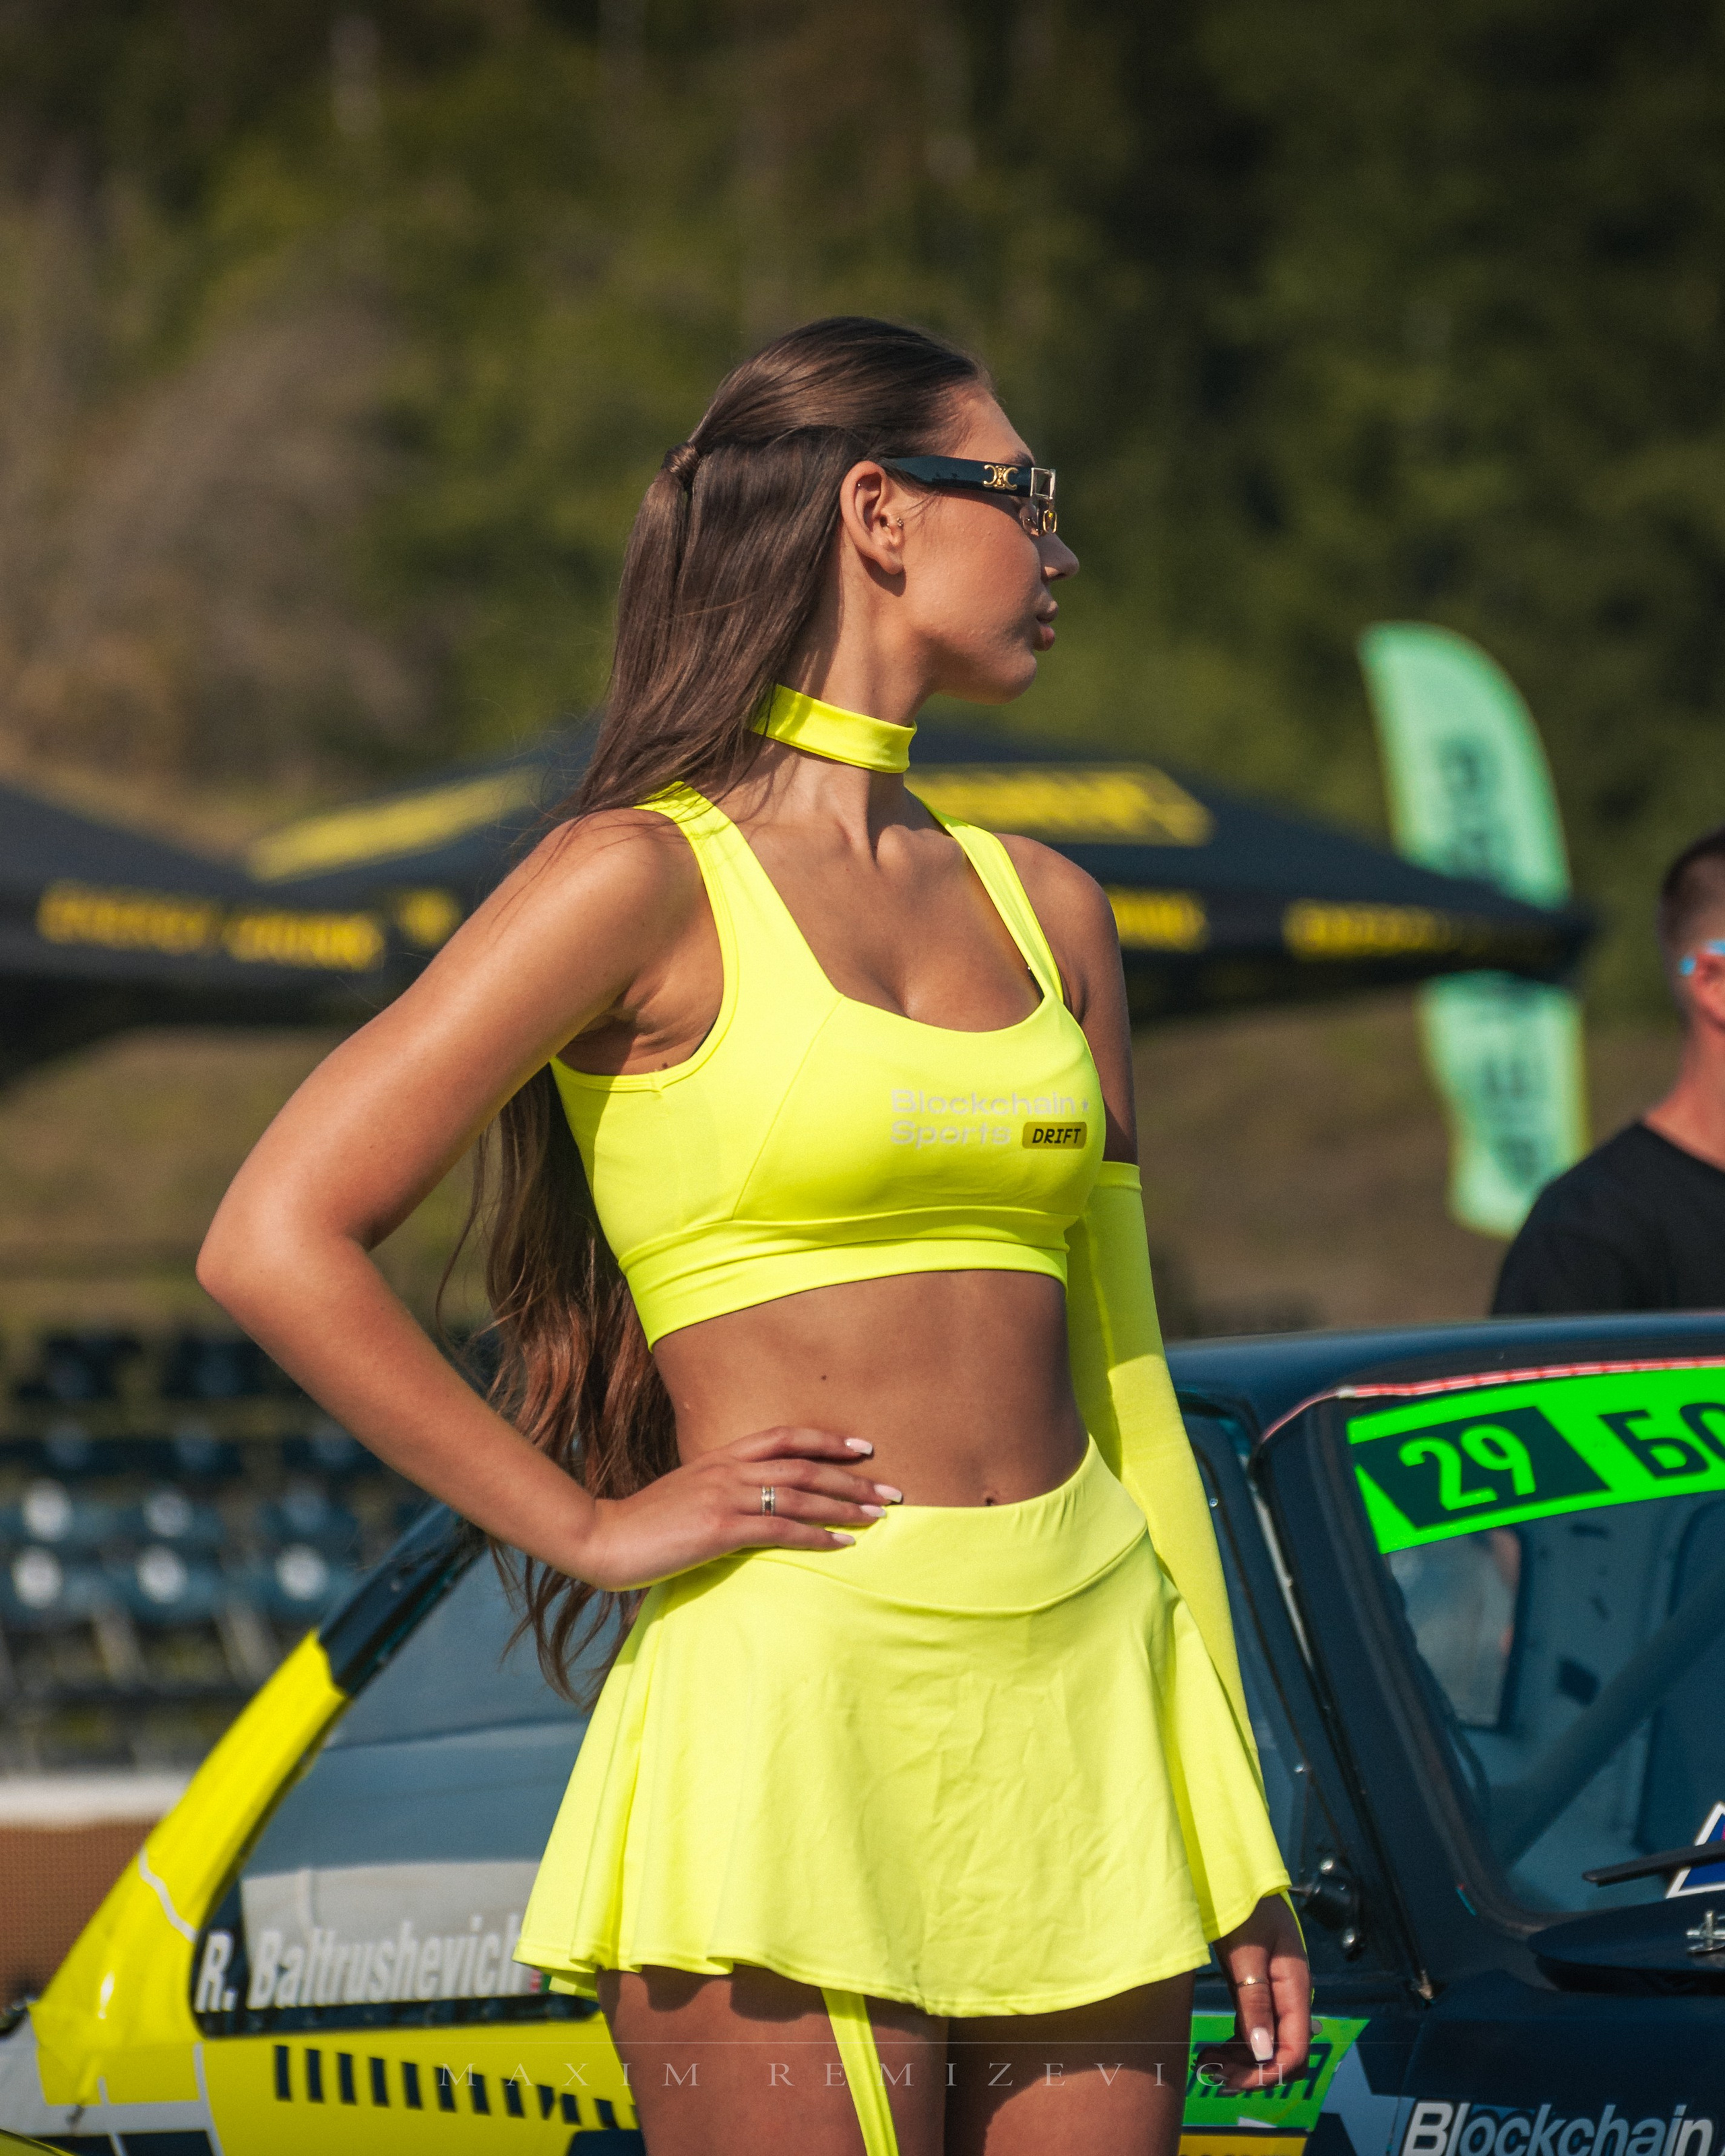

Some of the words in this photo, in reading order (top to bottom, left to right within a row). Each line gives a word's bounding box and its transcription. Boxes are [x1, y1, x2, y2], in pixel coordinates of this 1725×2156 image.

[891, 1088, 1077, 1116] Blockchain
[890, 1120, 1012, 1149] Sports
[1032, 1128, 1081, 1144] DRIFT
[1398, 1424, 1537, 1512] 29
[195, 1930, 237, 2013] R.
[246, 1912, 522, 2009] Baltrushevich
[1402, 2101, 1714, 2156] Blockchain
